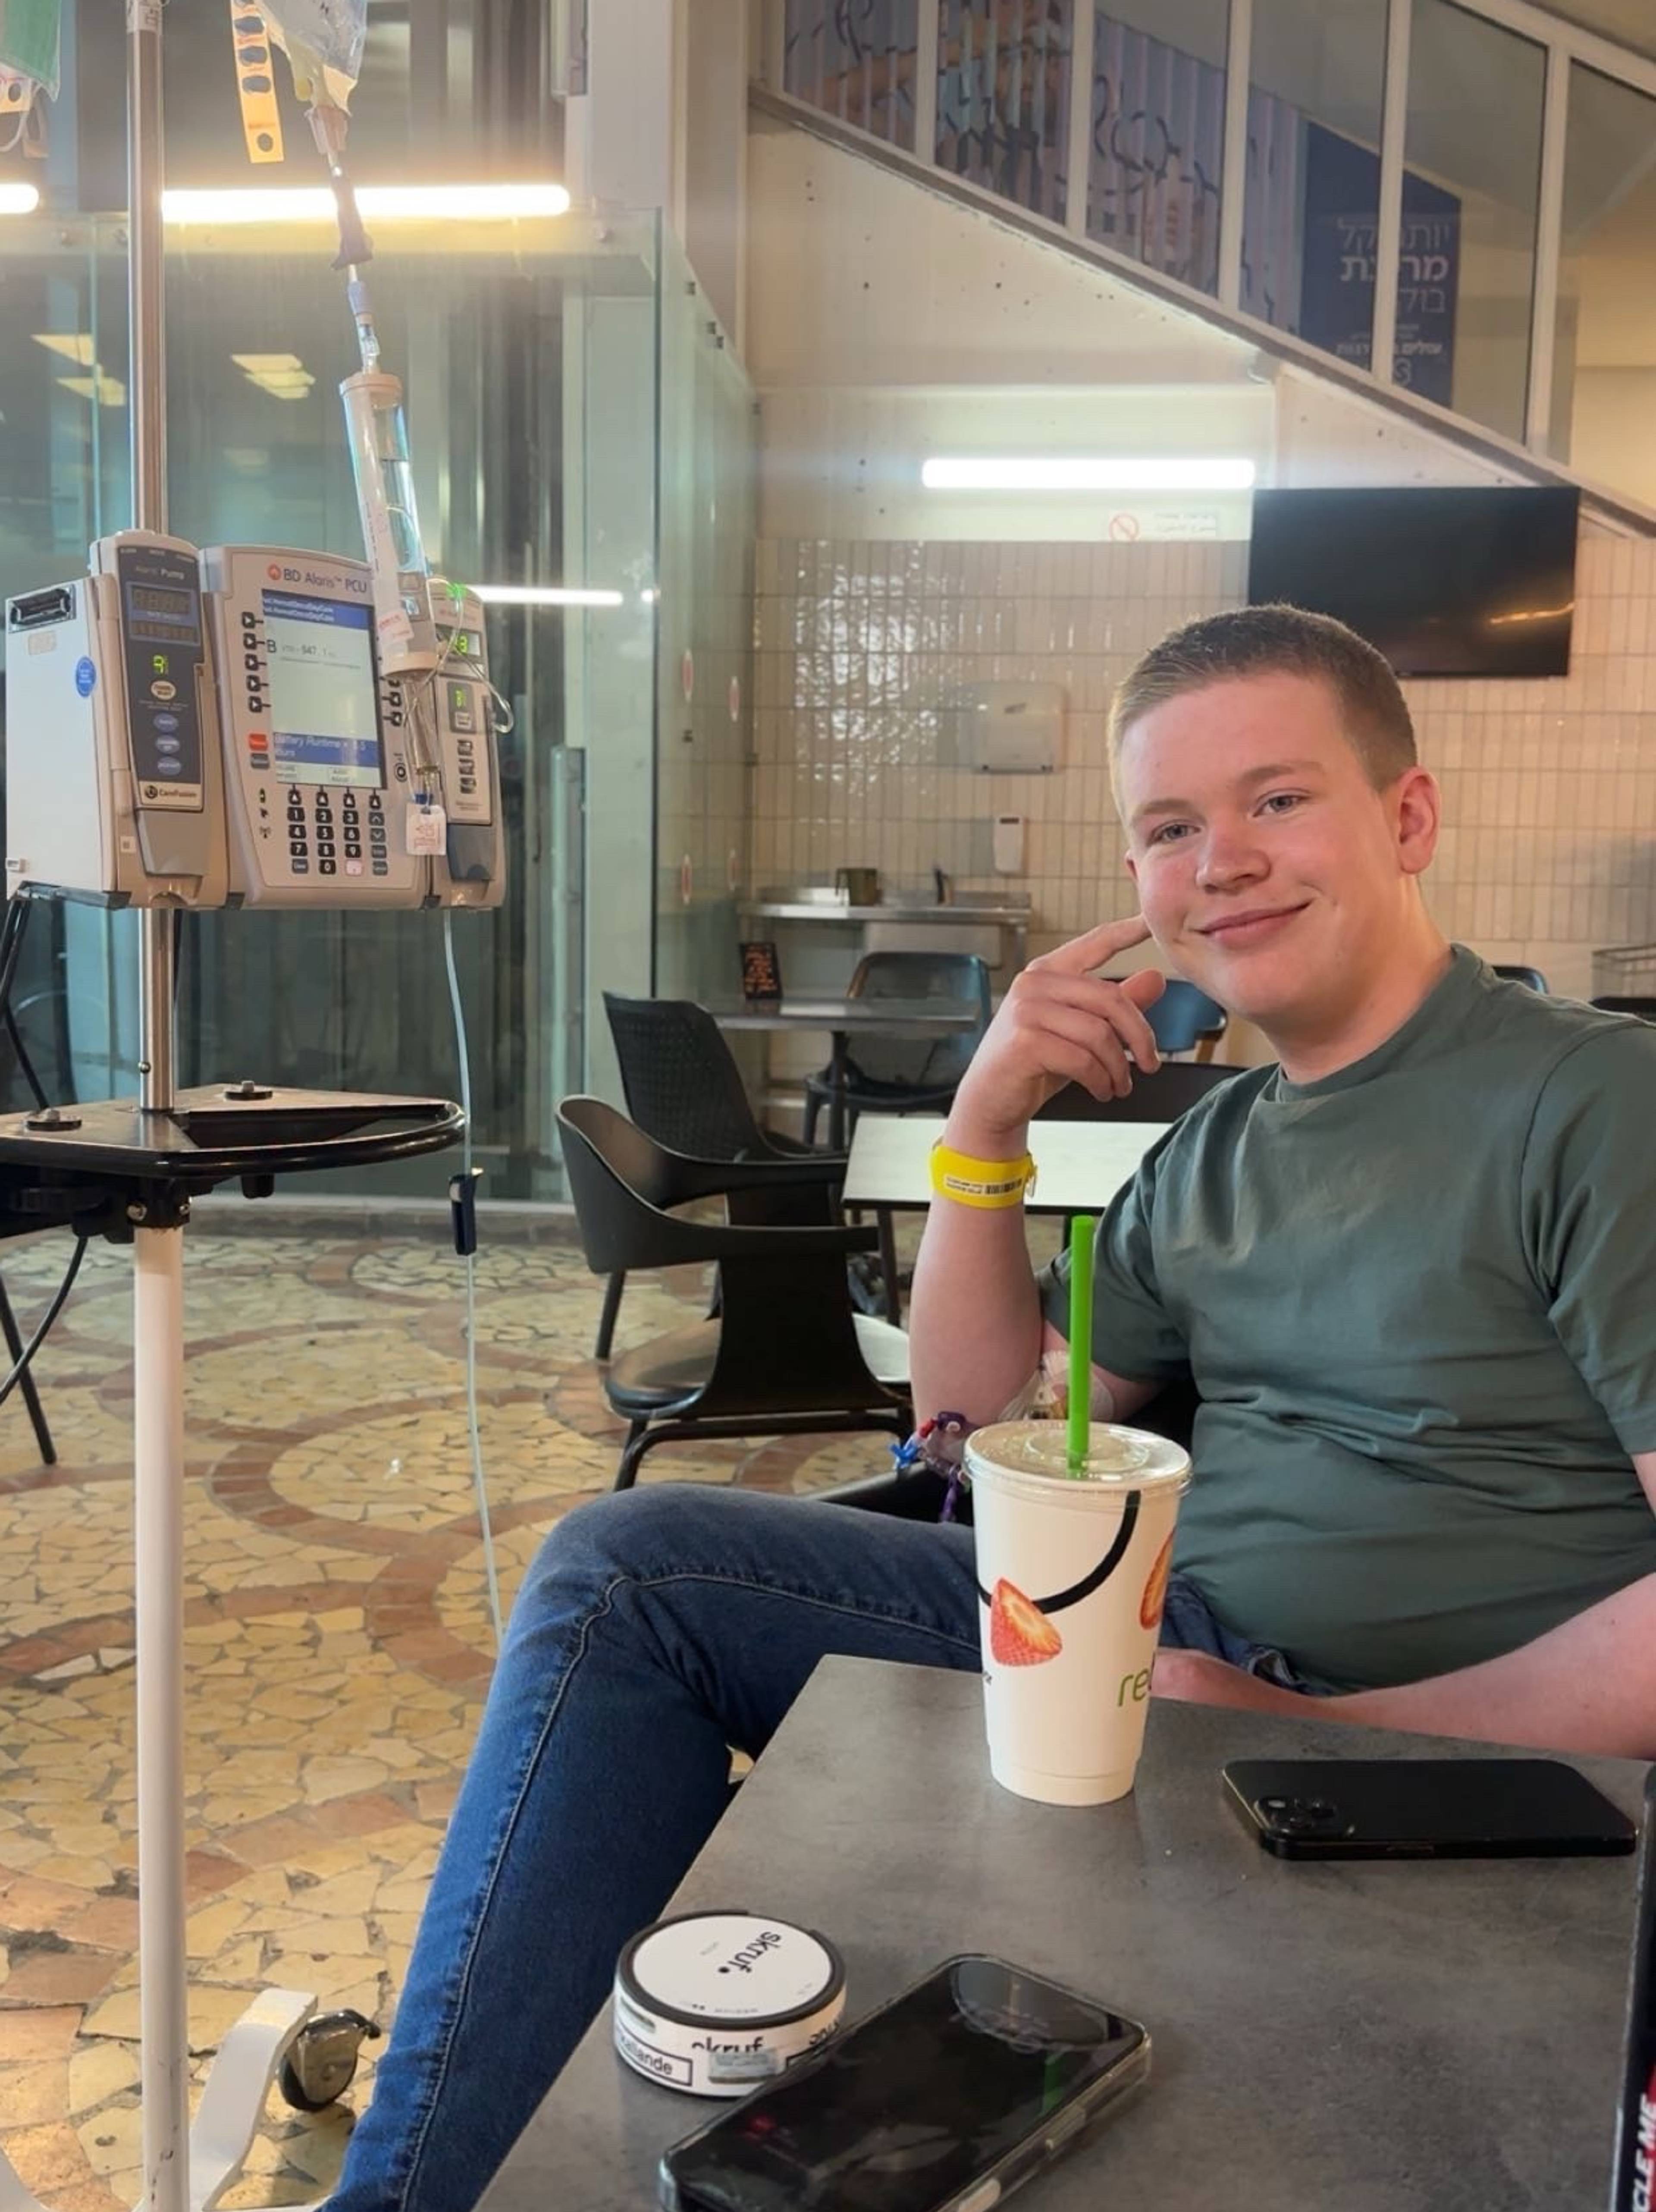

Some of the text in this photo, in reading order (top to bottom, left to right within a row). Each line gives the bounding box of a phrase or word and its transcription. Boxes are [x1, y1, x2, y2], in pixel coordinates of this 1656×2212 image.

[1400, 223, 1451, 251] יות
[284, 569, 301, 582] BD
[345, 578, 367, 593] PCU
[267, 639, 277, 653] B
[1119, 1661, 1153, 1706] re
